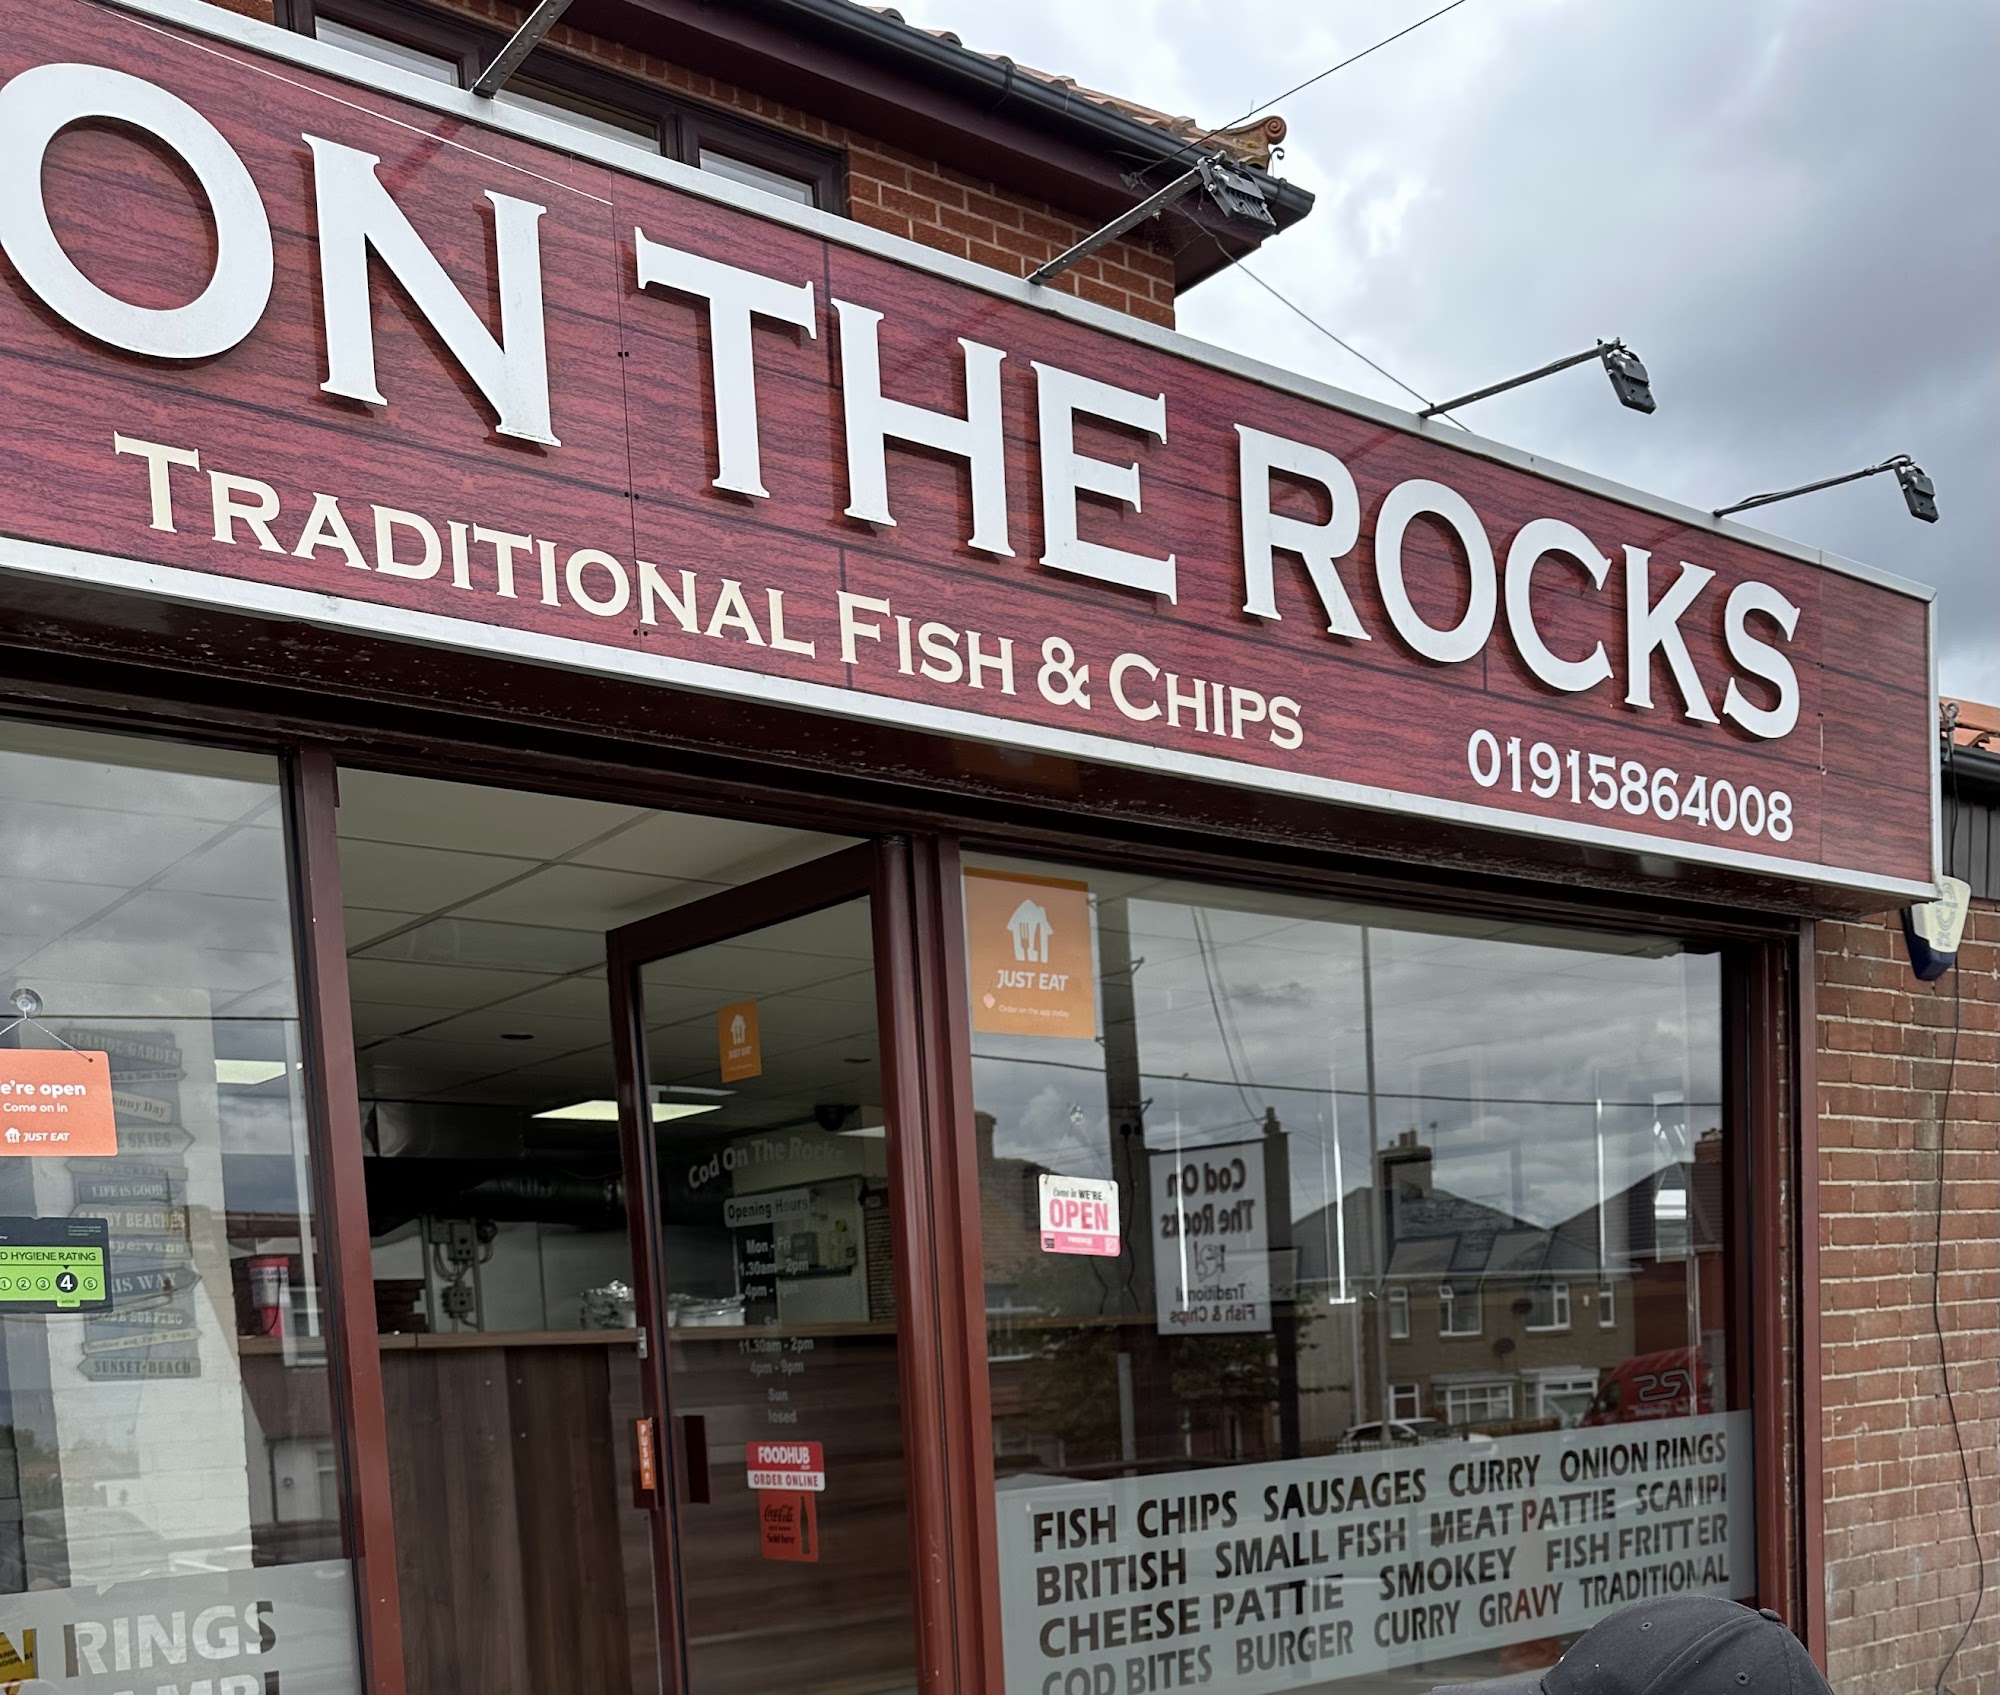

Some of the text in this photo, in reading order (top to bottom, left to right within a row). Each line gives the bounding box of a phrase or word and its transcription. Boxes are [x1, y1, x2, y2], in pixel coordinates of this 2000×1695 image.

[0, 63, 1801, 739] ON THE ROCKS
[113, 431, 1303, 750] TRADITIONAL FISH & CHIPS
[1467, 729, 1793, 842] 01915864008
[997, 969, 1069, 991] JUST EAT
[0, 1080, 86, 1098] e're open
[3, 1102, 69, 1113] Come on in
[23, 1132, 70, 1142] JUST EAT
[688, 1153, 719, 1189] Cod
[722, 1147, 749, 1171] On
[751, 1138, 785, 1162] The
[727, 1196, 810, 1221] Opening Hours
[1049, 1199, 1109, 1231] OPEN
[10, 1251, 56, 1261] HYGIENE
[58, 1252, 97, 1261] RATING
[746, 1239, 768, 1254] Mon
[785, 1258, 809, 1275] 2pm
[60, 1274, 74, 1291] 4
[745, 1283, 768, 1300] 4pm
[739, 1338, 782, 1354] 11.30am
[790, 1336, 815, 1354] 2pm
[750, 1361, 773, 1378] 4pm
[781, 1359, 805, 1377] 9pm
[768, 1387, 788, 1402] Sun
[758, 1446, 810, 1464] FOODHUB
[754, 1473, 819, 1487] ORDER ONLINE
[1033, 1432, 1726, 1553] FISH CHIPS SAUSAGES CURRY ONION RINGS
[1036, 1472, 1728, 1606] BRITISH SMALL FISH MEAT PATTIE SCAMPI
[1039, 1513, 1728, 1658] CHEESE PATTIE SMOKEY FISH FRITTER
[1126, 1644, 1212, 1695] BITES
[1236, 1619, 1354, 1675] BURGER
[1374, 1600, 1461, 1648] CURRY
[1479, 1582, 1563, 1628] GRAVY
[1579, 1554, 1730, 1609] TRADITIONAL
[64, 1600, 277, 1678] RINGS
